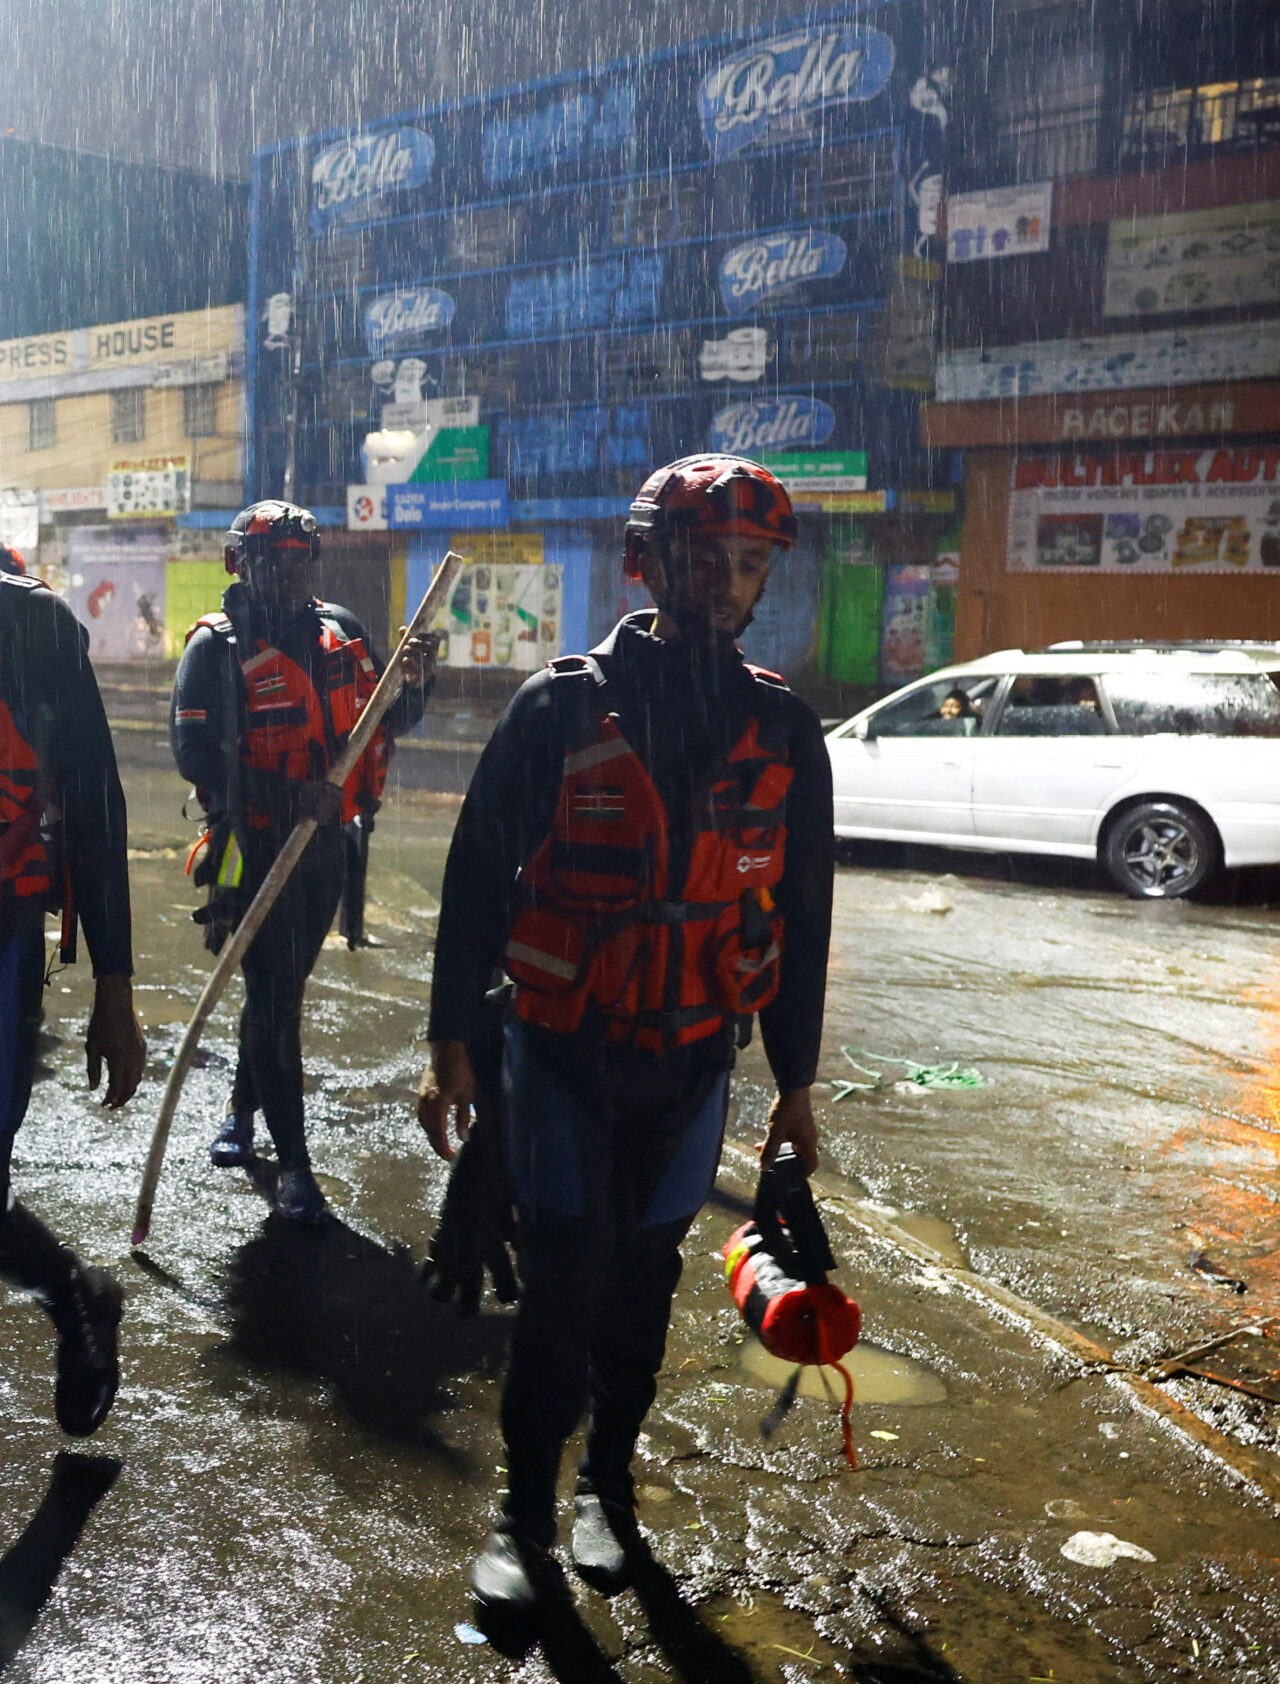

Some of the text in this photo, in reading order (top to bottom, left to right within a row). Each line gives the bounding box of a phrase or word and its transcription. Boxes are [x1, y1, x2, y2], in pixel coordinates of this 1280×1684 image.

[706, 33, 861, 132] Bella
[312, 133, 413, 209] Bella
[724, 236, 826, 297] Bella
[96, 321, 176, 357] HOUSE
[369, 291, 442, 338] Bella
[716, 401, 811, 453] Bella
